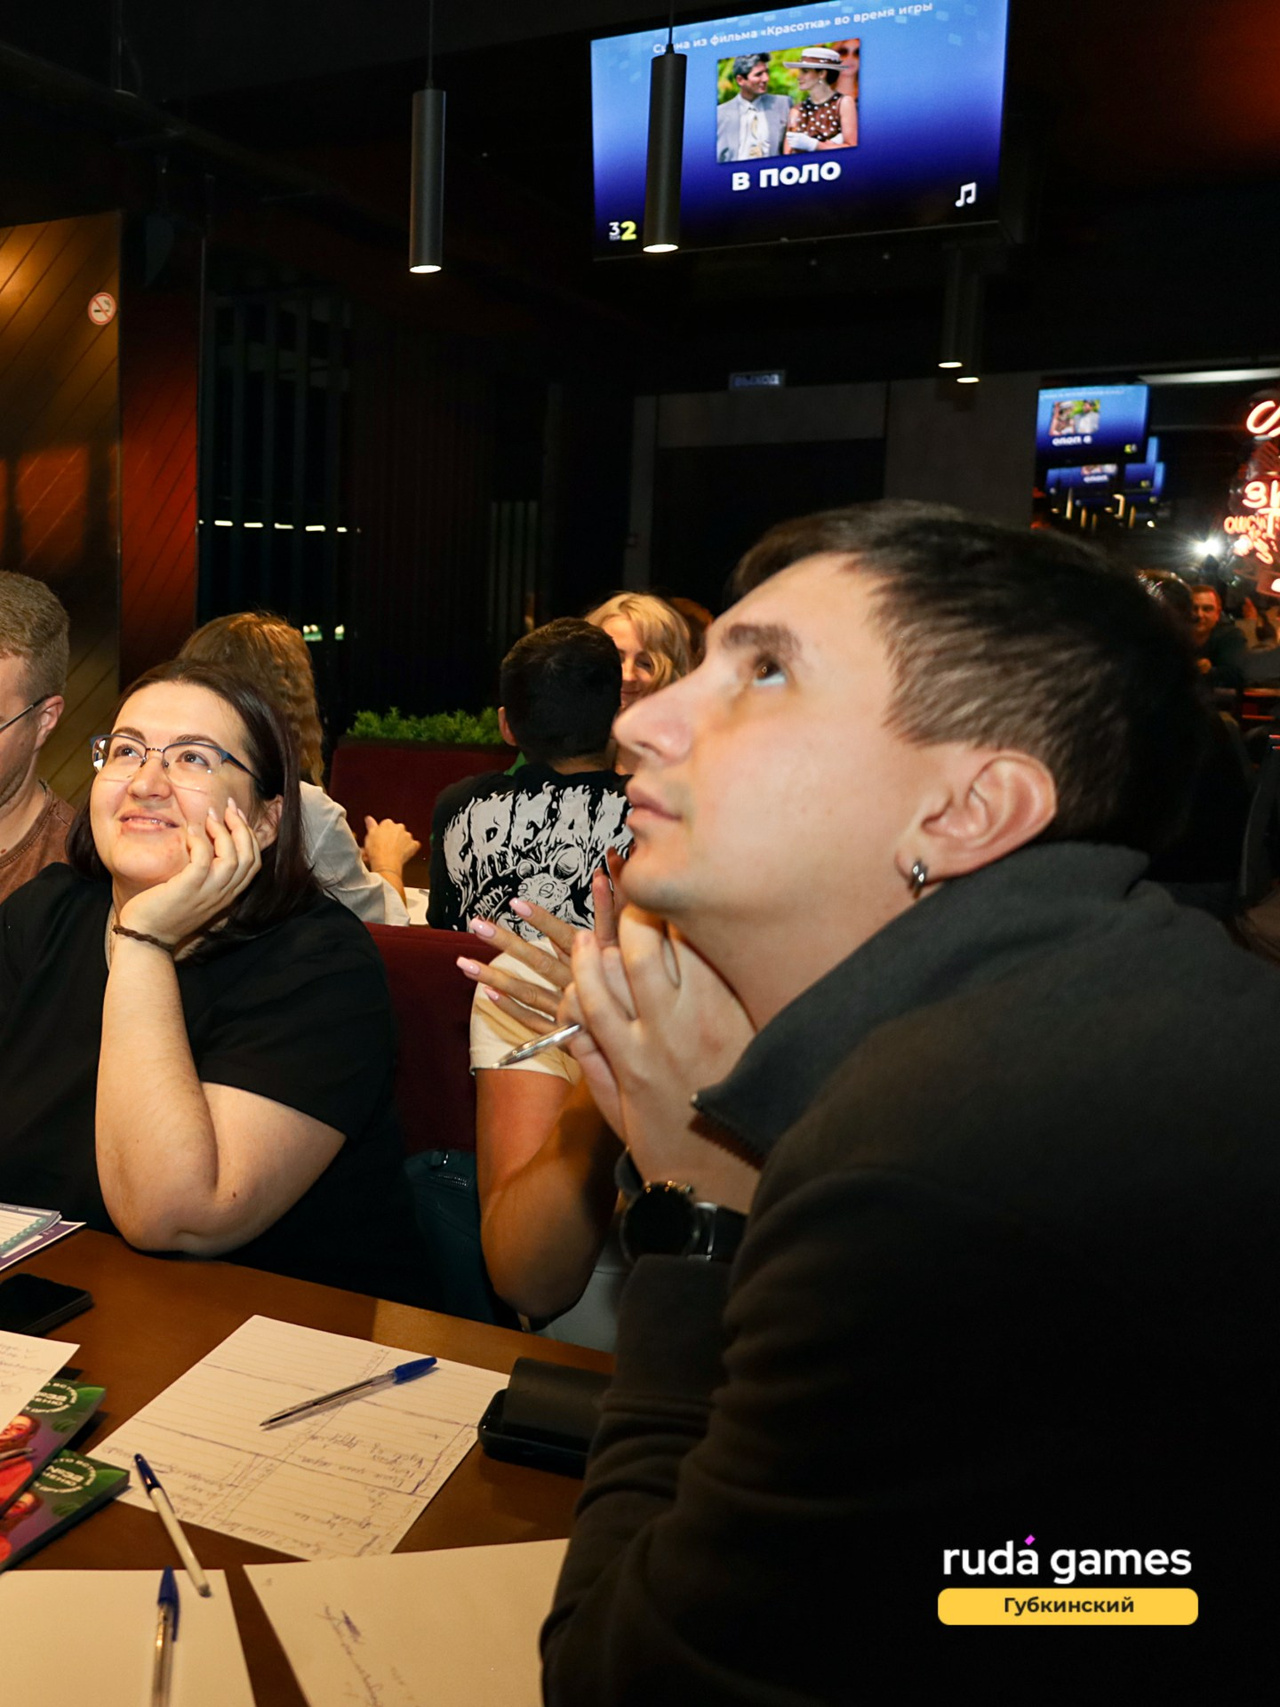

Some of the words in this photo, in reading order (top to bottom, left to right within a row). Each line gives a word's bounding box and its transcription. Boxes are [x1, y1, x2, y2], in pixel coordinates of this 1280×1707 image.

[653, 40, 691, 54] Сцна
[693, 38, 708, 47] из
[709, 30, 758, 47] фильма
[760, 19, 831, 36] «Красотка»
[834, 16, 851, 26] во
[853, 8, 895, 23] время
[898, 3, 933, 16] игры
